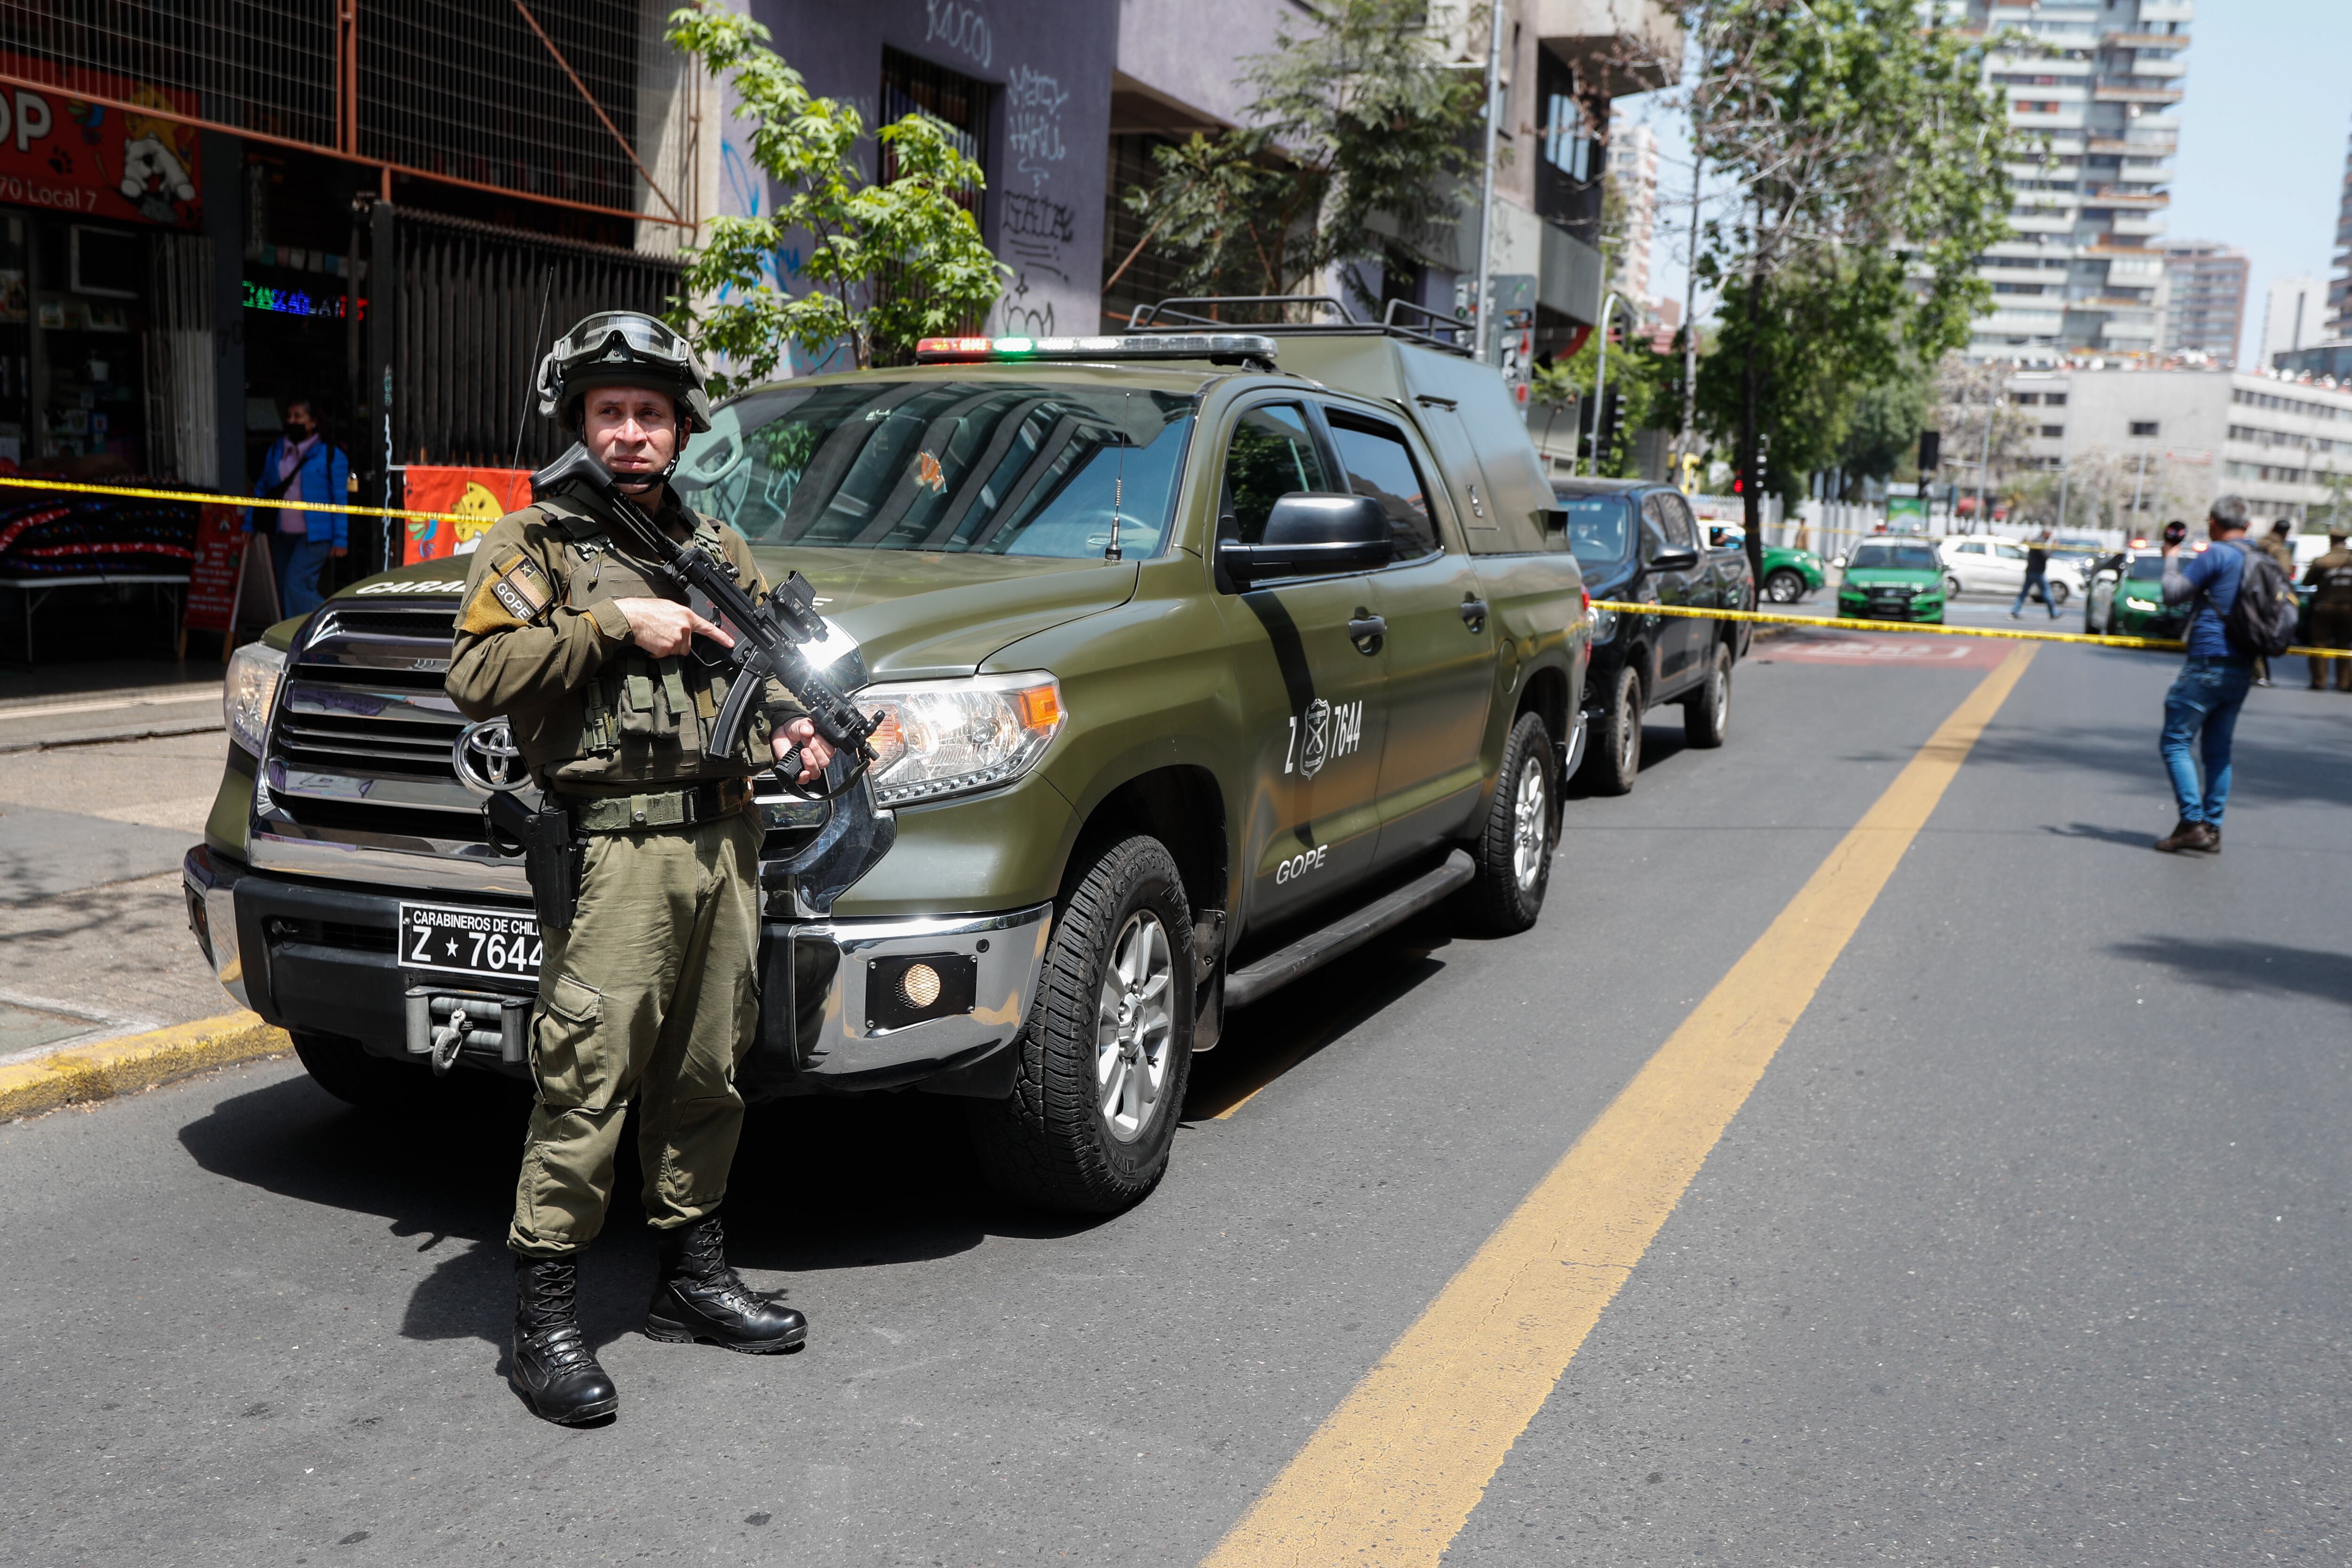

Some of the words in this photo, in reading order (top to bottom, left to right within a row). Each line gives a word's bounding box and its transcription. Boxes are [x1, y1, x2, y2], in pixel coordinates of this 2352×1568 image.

[27, 179, 80, 210] Local
[86, 190, 97, 212] 7
[356, 580, 466, 595] CARA
[497, 583, 531, 621] GOPE
[1285, 716, 1297, 774] Z
[1331, 700, 1362, 758] 7644
[1276, 844, 1328, 885] GOPE
[413, 910, 491, 931] CARABINEROS
[493, 918, 509, 933] DE
[411, 924, 432, 963] Z
[469, 931, 543, 972] 7644
